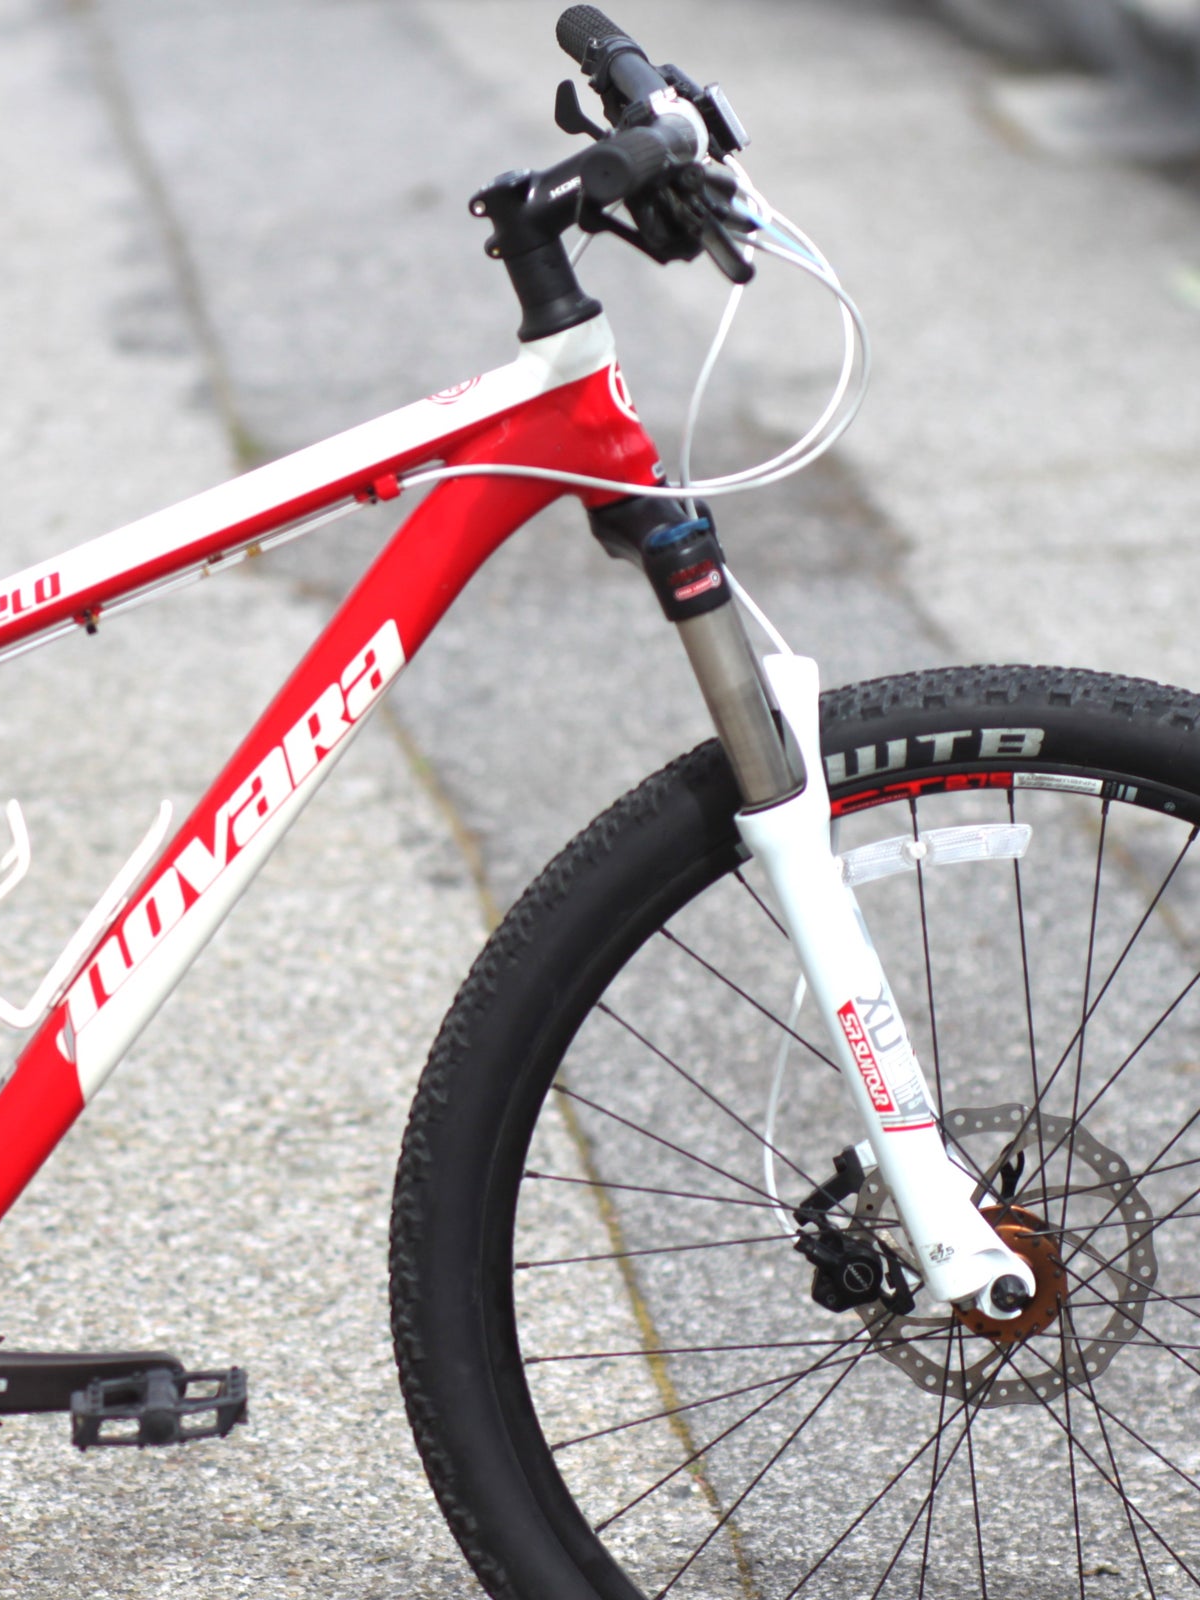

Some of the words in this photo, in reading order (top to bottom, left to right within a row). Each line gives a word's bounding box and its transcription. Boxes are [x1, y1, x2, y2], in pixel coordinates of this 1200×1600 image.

[549, 176, 582, 199] KOR
[824, 727, 1045, 786] WTB
[840, 1013, 863, 1041] SR
[851, 1040, 890, 1107] SUNTOUR
